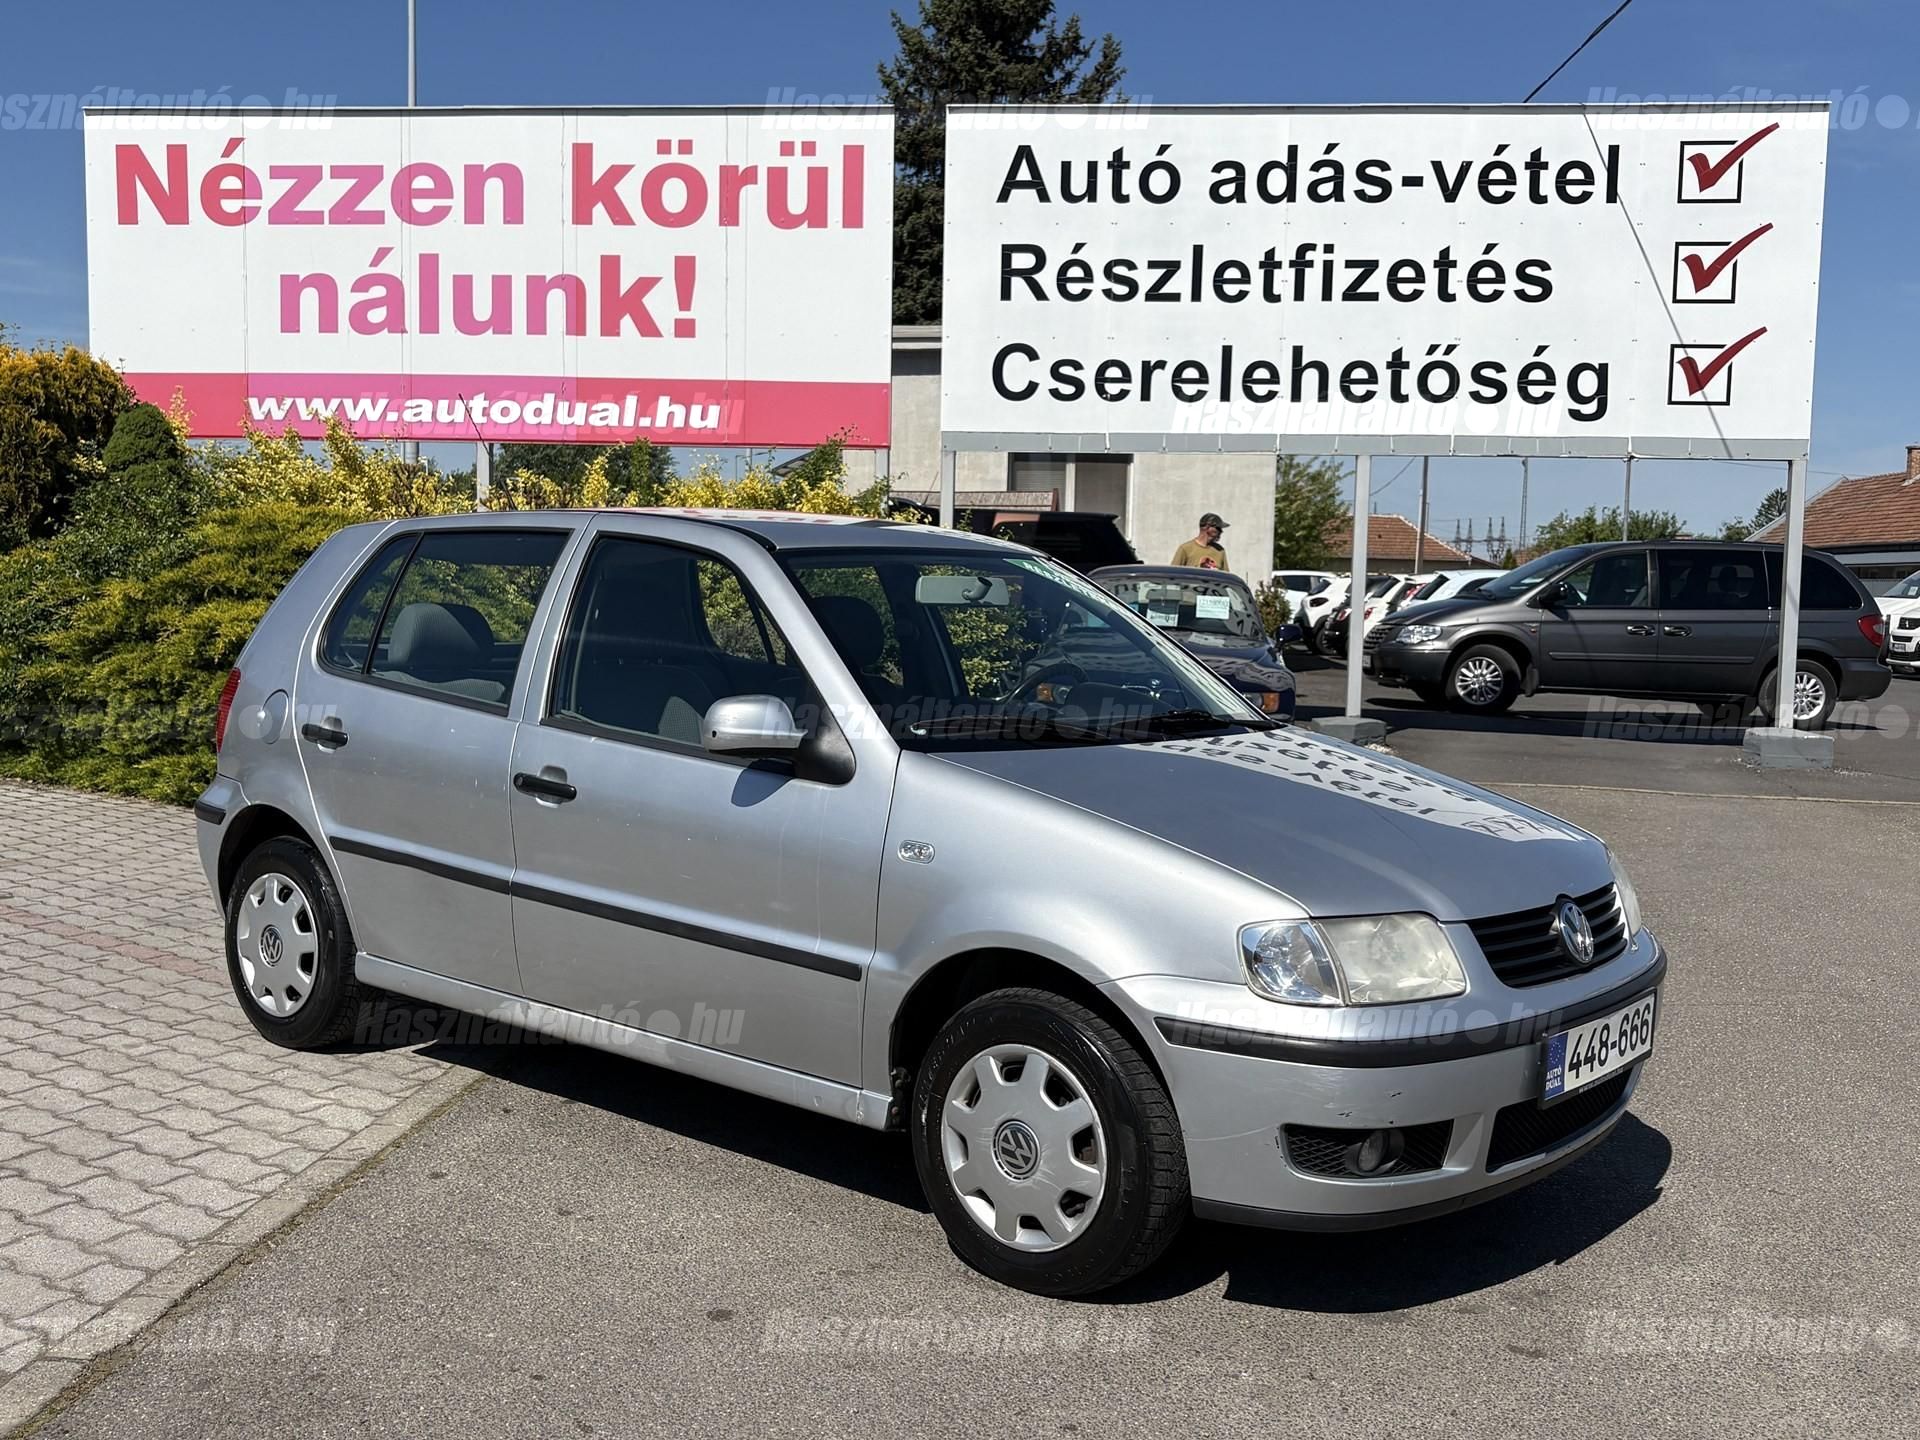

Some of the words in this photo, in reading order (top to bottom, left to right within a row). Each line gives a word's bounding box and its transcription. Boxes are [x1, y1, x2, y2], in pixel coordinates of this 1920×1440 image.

[115, 138, 524, 226] Nézzen
[572, 139, 865, 230] körül
[996, 144, 1181, 204] Autó
[1209, 142, 1620, 205] adás-vétel
[280, 247, 696, 338] nálunk!
[1000, 242, 1553, 304] Részletfizetés
[247, 394, 720, 430] www.autodual.hu
[992, 342, 1609, 422] Cserelehetőség
[1567, 1002, 1652, 1080] 448-666
